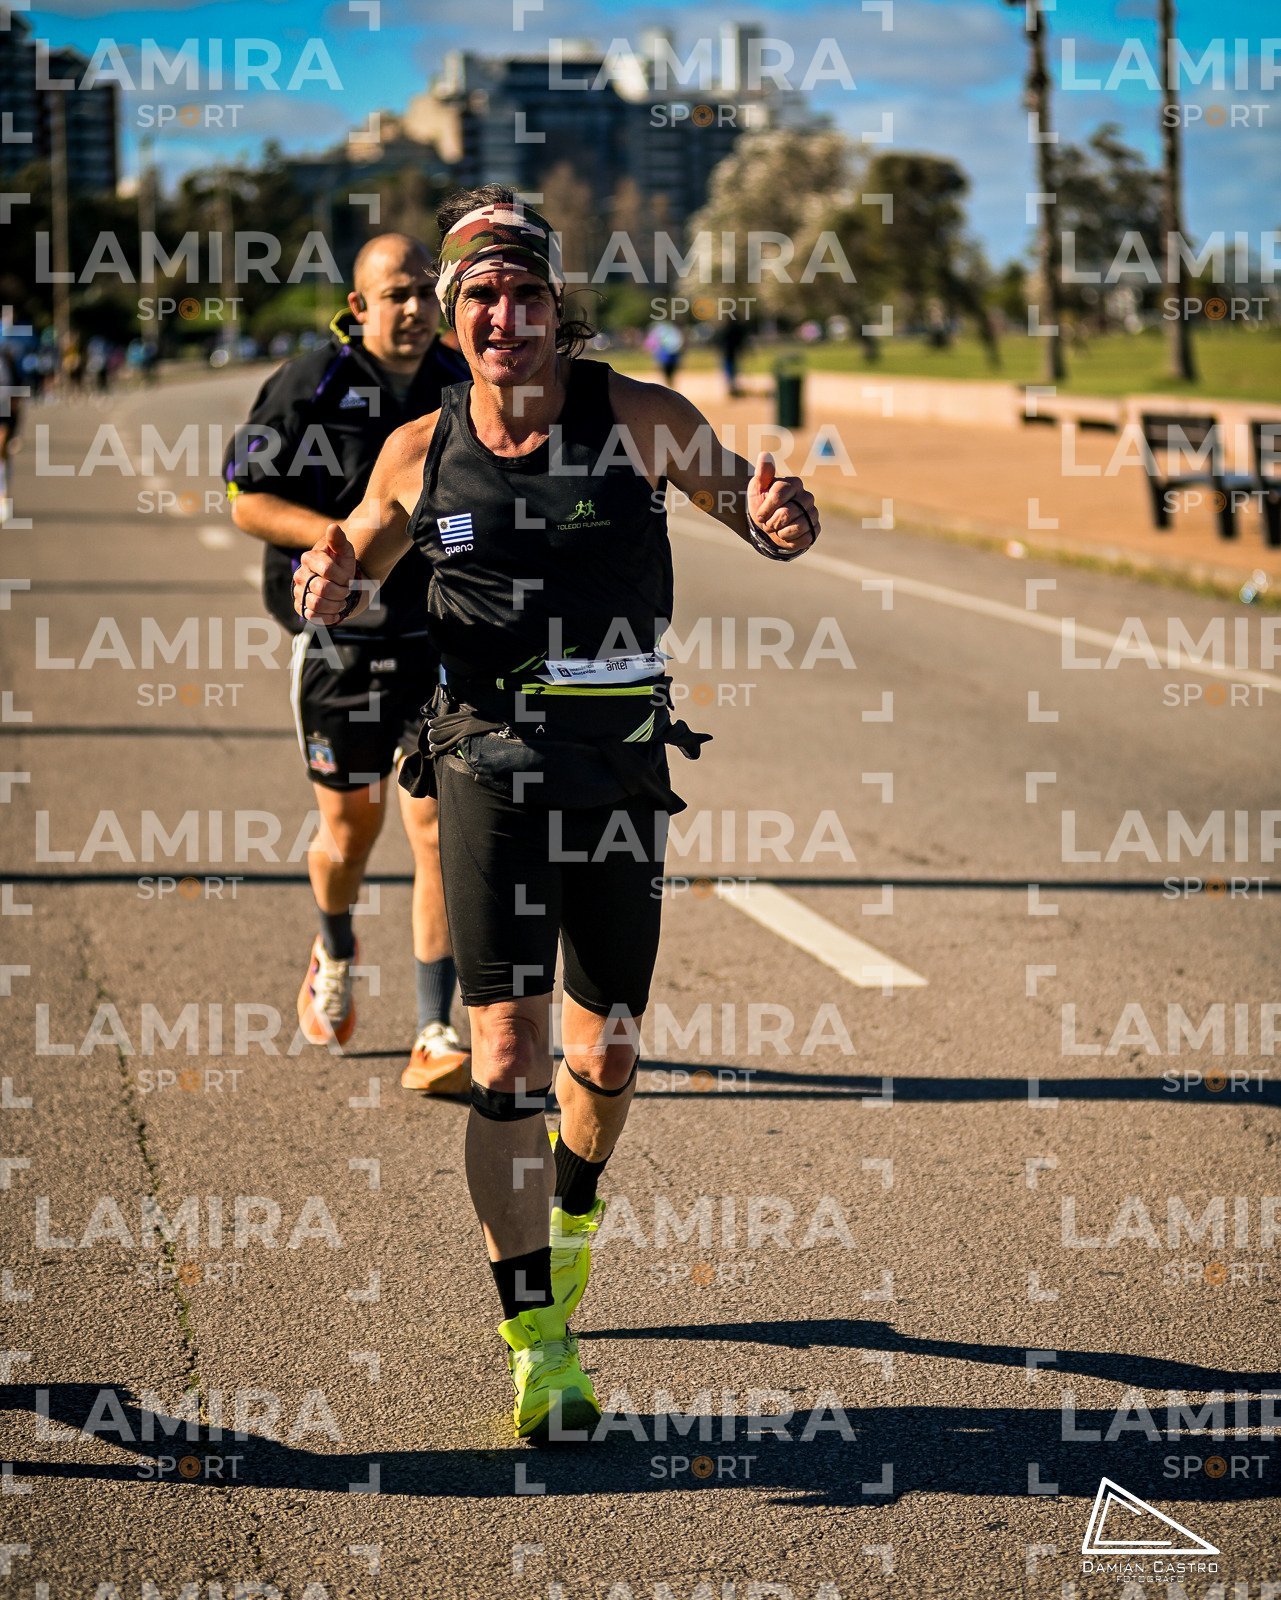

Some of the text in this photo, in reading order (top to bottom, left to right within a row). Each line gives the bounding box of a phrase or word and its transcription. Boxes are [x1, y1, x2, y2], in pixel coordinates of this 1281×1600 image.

[557, 519, 611, 530] TOLEDO RUNNING
[606, 659, 628, 672] antel
